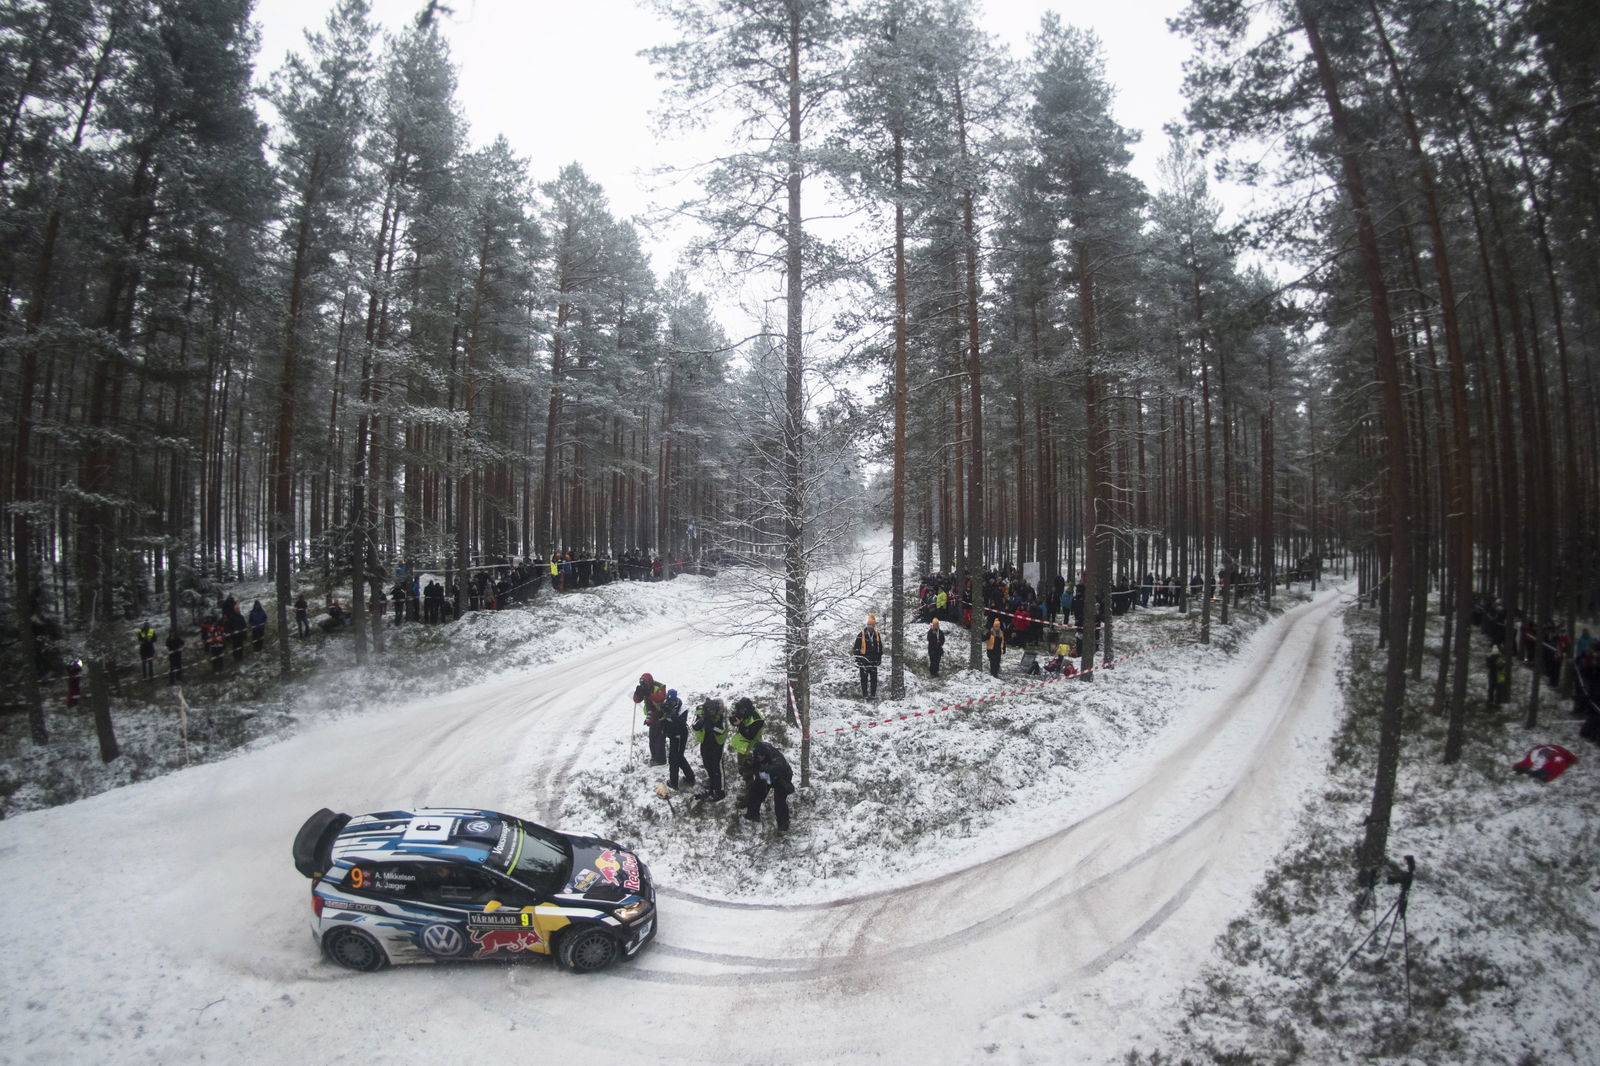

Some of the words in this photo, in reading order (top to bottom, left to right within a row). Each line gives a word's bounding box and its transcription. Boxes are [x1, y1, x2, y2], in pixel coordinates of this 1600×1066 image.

[351, 867, 363, 888] 9
[383, 872, 416, 881] Mikkelsen
[383, 881, 406, 890] Jæger
[471, 913, 517, 925] VÄRMLAND
[521, 913, 529, 926] 9
